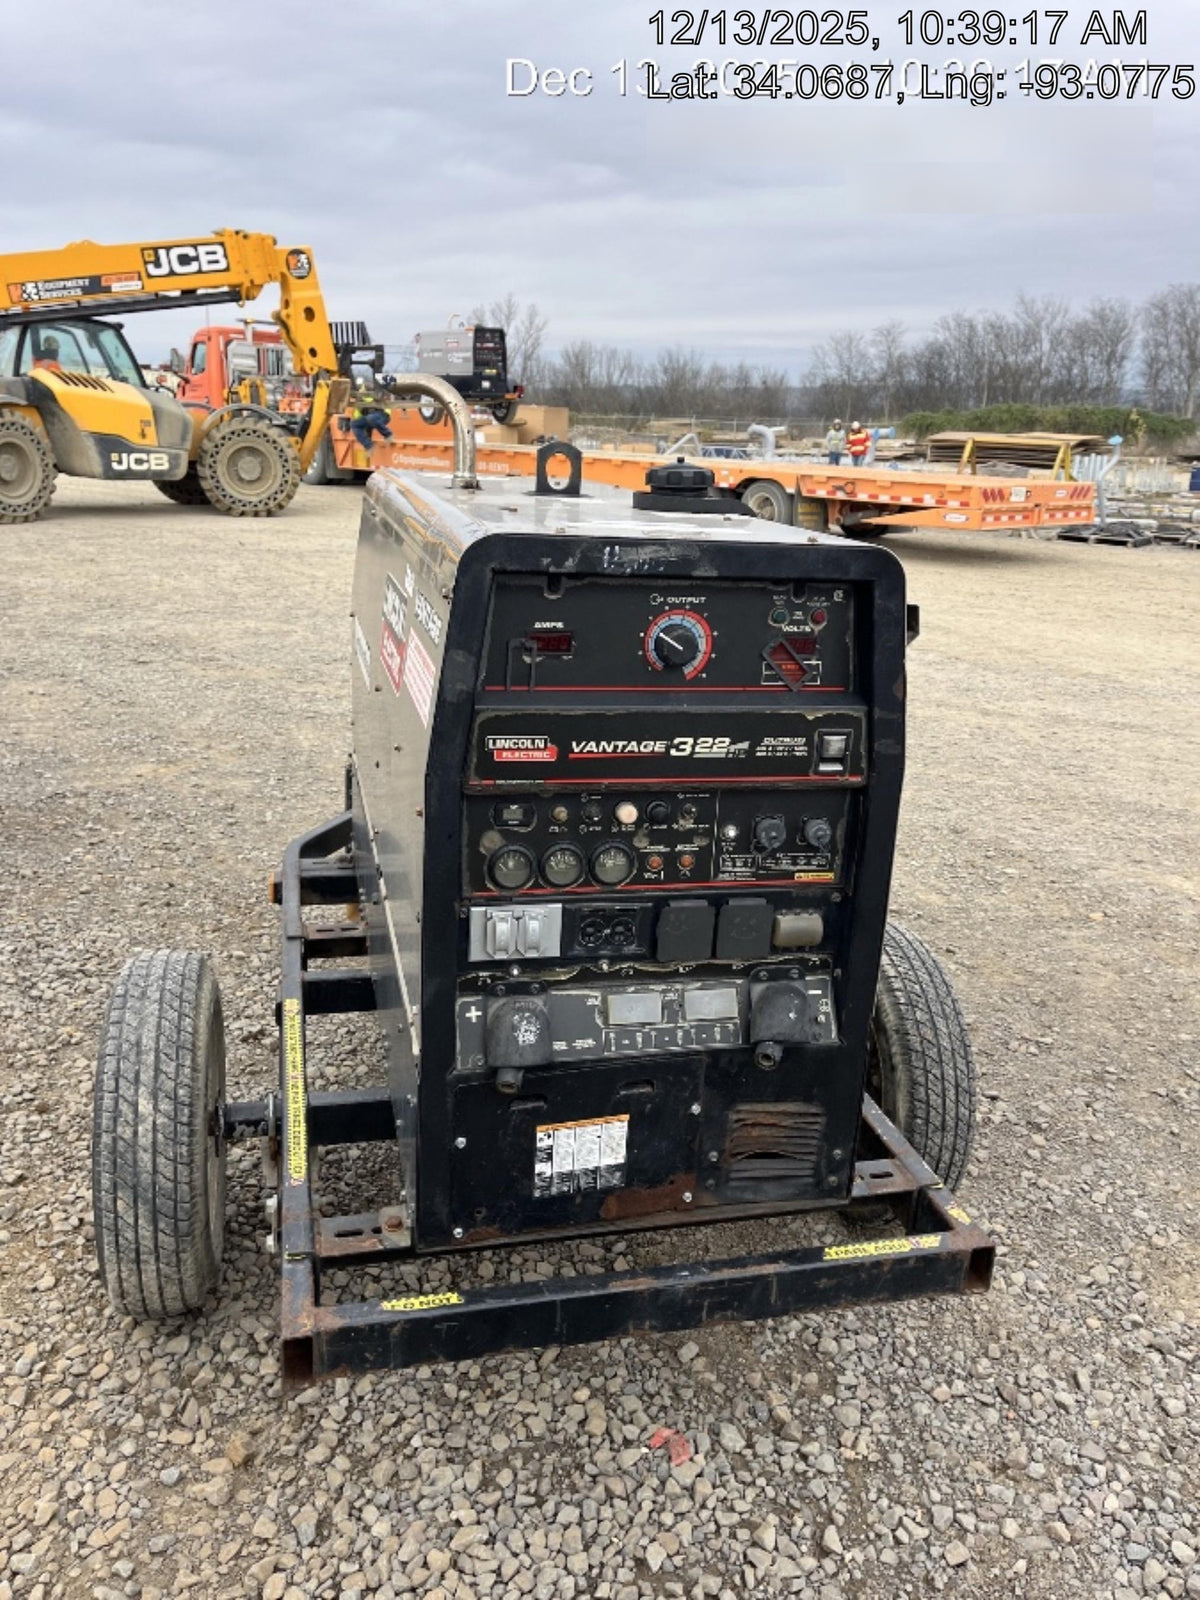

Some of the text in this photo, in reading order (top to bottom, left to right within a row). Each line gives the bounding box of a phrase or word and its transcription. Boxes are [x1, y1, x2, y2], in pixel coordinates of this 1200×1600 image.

[144, 244, 228, 277] JCB
[111, 453, 170, 470] JCB
[667, 596, 707, 604] OUTPUT
[488, 738, 545, 749] LINCOLN
[571, 740, 667, 753] VANTAGE
[670, 736, 731, 757] 322
[502, 751, 550, 759] ELECTRIC
